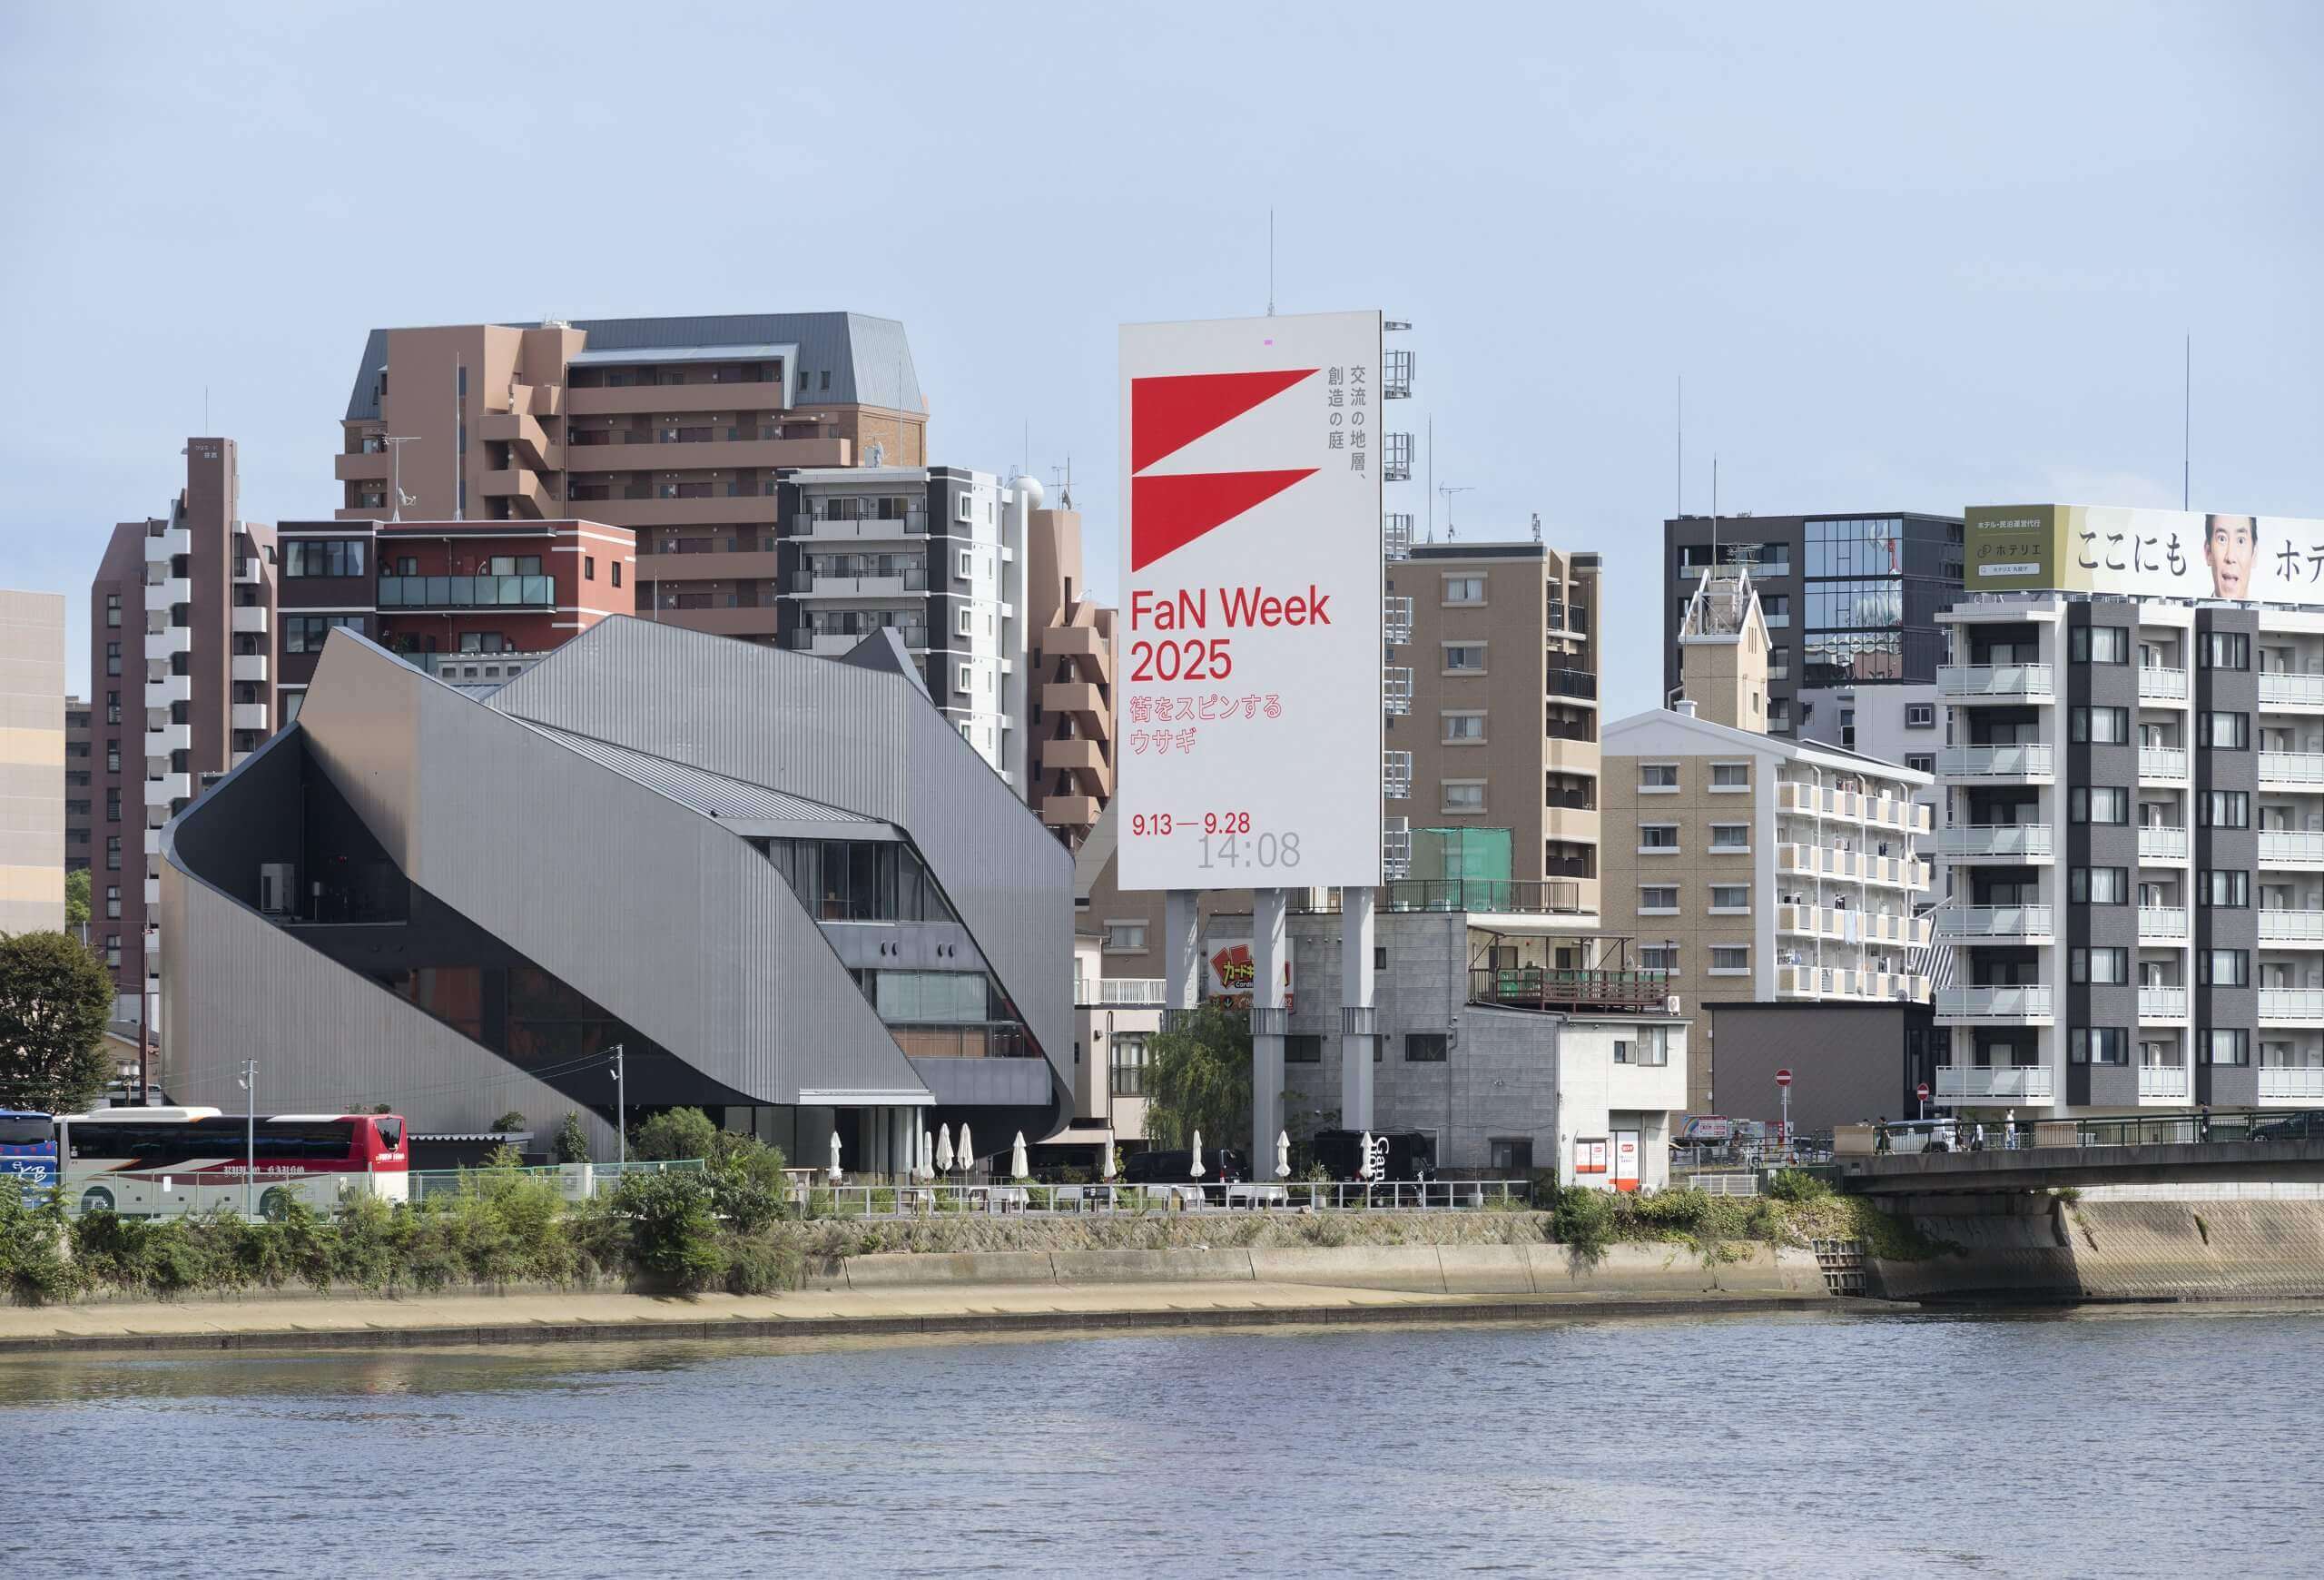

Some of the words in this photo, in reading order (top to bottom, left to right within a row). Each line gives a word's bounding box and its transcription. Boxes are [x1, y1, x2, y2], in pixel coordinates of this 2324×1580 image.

[1328, 366, 1344, 449] 創造の庭
[1350, 364, 1366, 479] 交流の地層、
[1996, 544, 2041, 557] ホテリエ
[2078, 530, 2187, 577] ここにも
[1131, 588, 1206, 631] FaN
[1219, 584, 1332, 627] Week
[1130, 638, 1232, 682] 2025
[1129, 693, 1282, 724] 街をスピンする
[1129, 726, 1196, 755] ウサギ
[1197, 831, 1301, 869] 14:08
